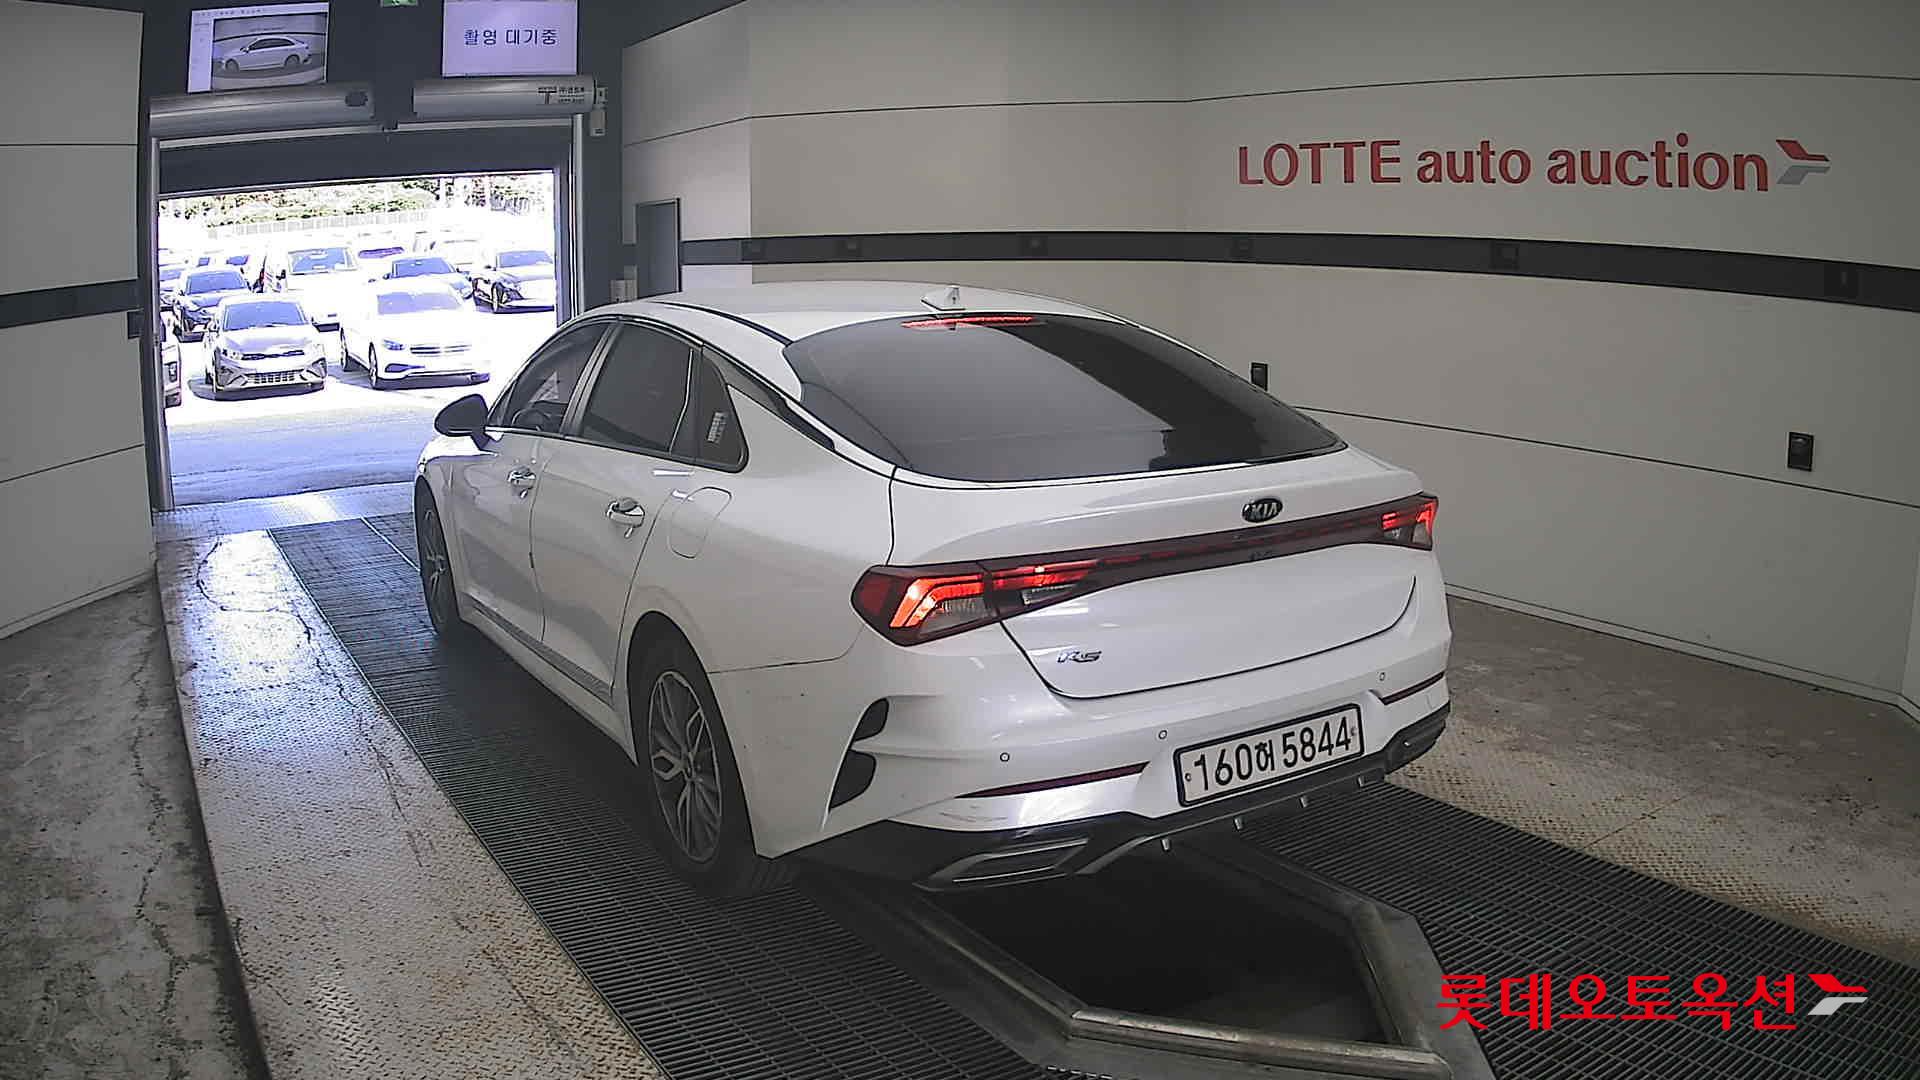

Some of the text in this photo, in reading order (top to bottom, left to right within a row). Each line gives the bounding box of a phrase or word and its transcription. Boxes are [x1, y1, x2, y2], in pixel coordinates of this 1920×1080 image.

[463, 28, 558, 46] 촬영 대기중
[1238, 131, 1769, 192] LOTTE auto auction
[1193, 715, 1352, 792] 160허 5844
